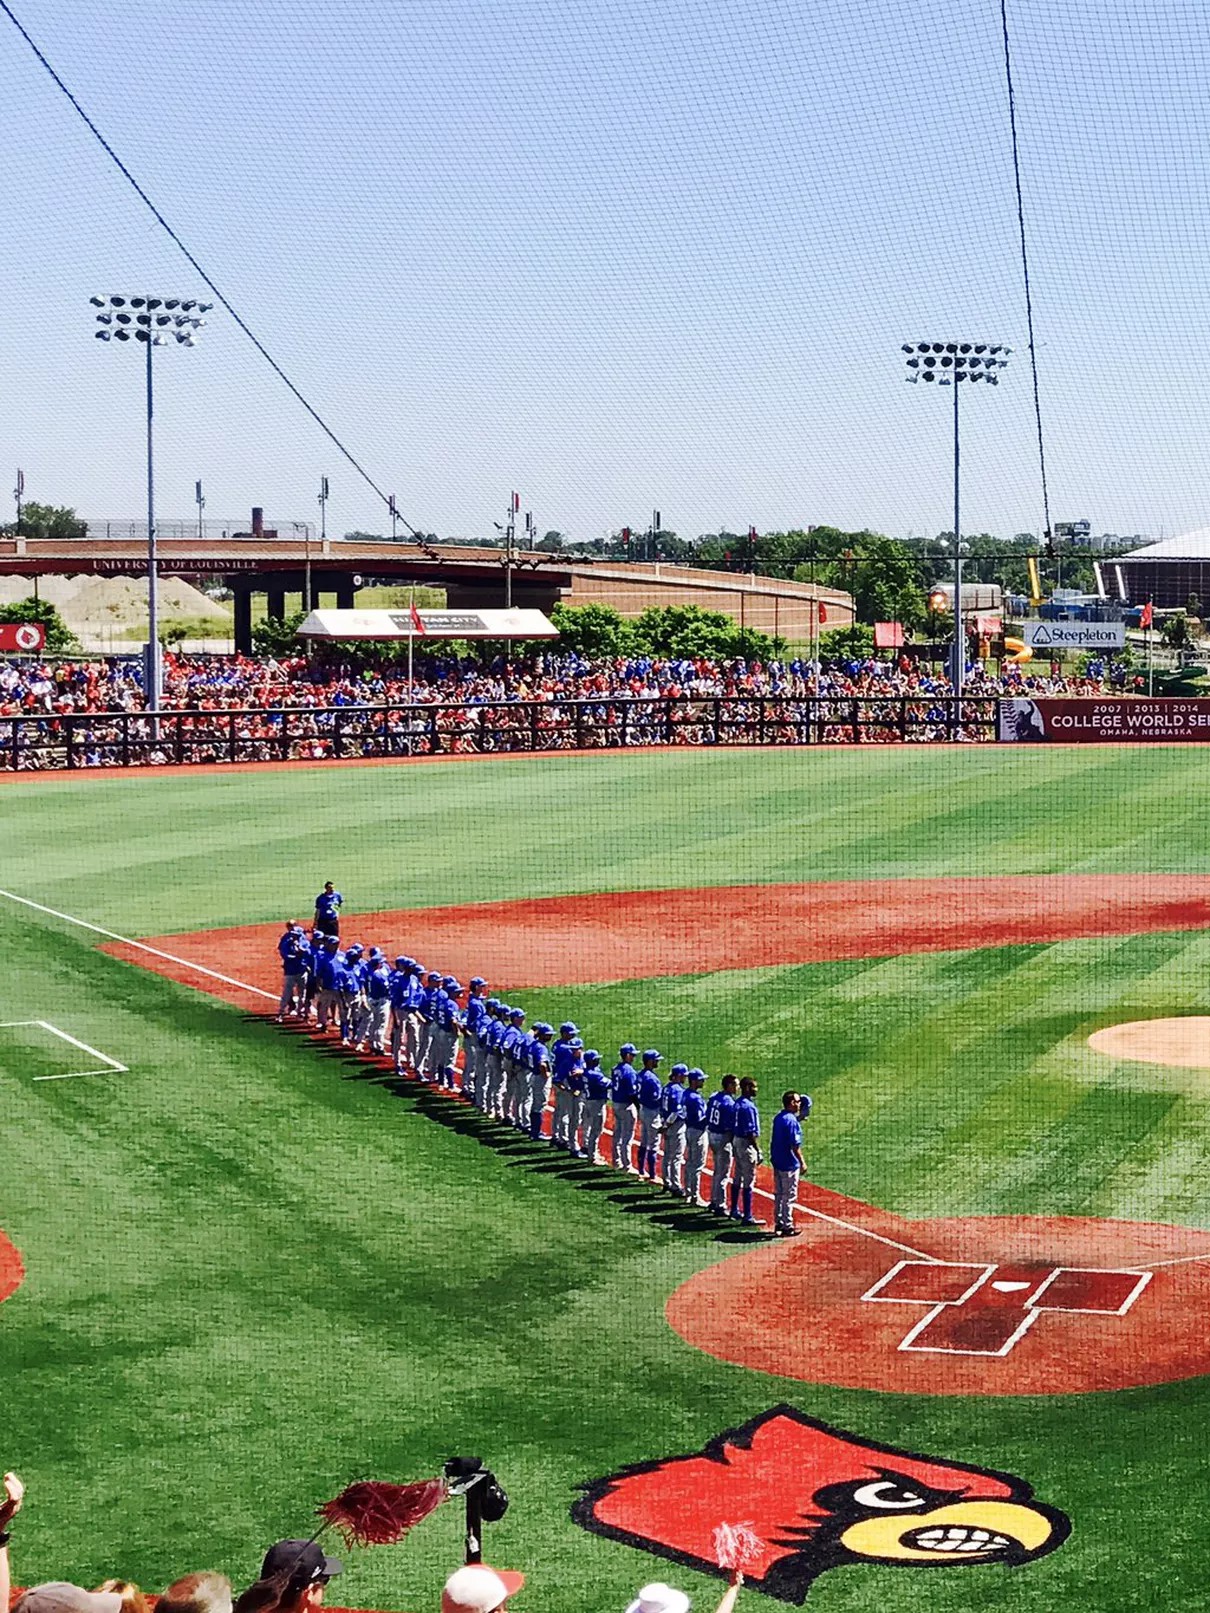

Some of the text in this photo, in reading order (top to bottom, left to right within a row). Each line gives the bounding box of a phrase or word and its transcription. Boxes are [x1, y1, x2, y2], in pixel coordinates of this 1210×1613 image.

[93, 559, 258, 570] UNIVERSY OF LOUISVILLE
[1052, 627, 1116, 644] Steepleton
[1093, 705, 1121, 713] 2007
[1172, 704, 1199, 713] 2014
[1051, 715, 1122, 728] COLLEGE
[1127, 715, 1184, 727] WORLD
[1142, 728, 1192, 736] NEBRASKA
[709, 1107, 721, 1125] 19
